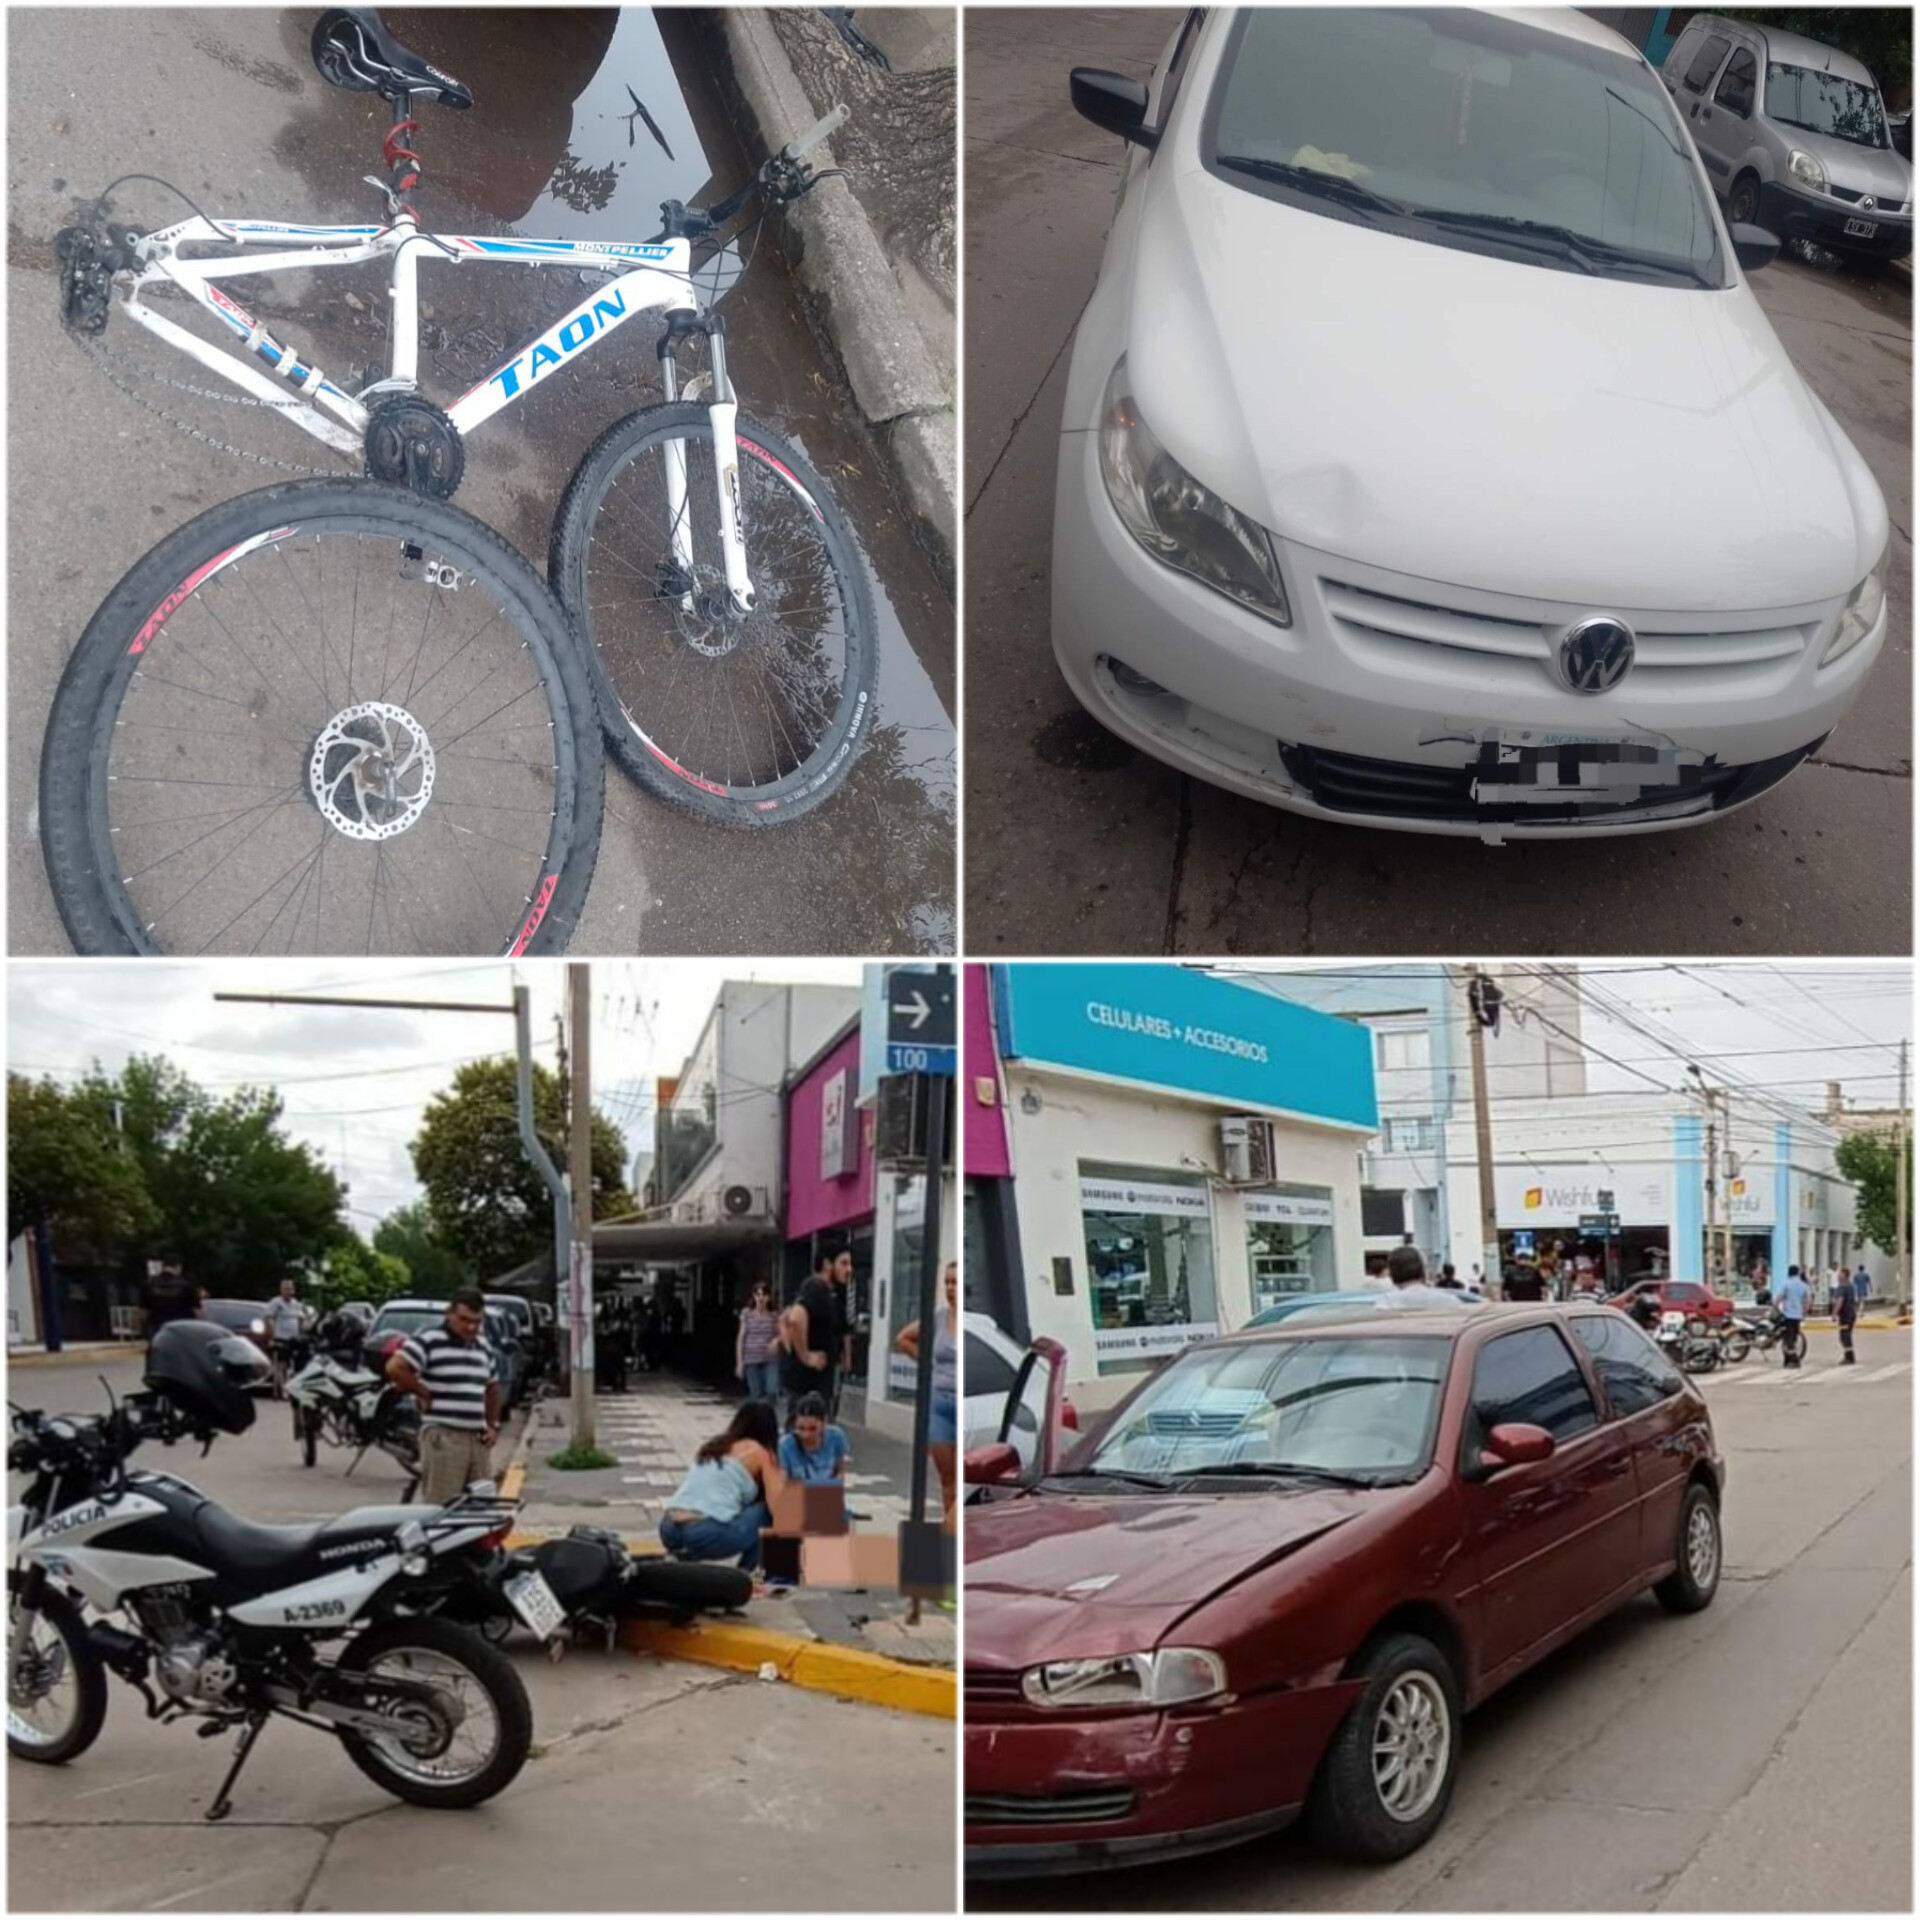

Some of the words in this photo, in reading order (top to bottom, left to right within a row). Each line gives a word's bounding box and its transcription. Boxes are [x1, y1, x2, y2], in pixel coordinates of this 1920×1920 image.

[573, 242, 669, 257] MONTPELLIER
[489, 288, 627, 399] TAON
[1086, 1001, 1172, 1040] CELULARES
[1184, 1025, 1268, 1064] ACCESORIOS
[892, 1048, 928, 1071] 100
[1081, 1188, 1124, 1200] SAMSUNG
[42, 1505, 106, 1539] POLICIA
[319, 1538, 386, 1560] HONDA
[284, 1600, 346, 1623] A-2369
